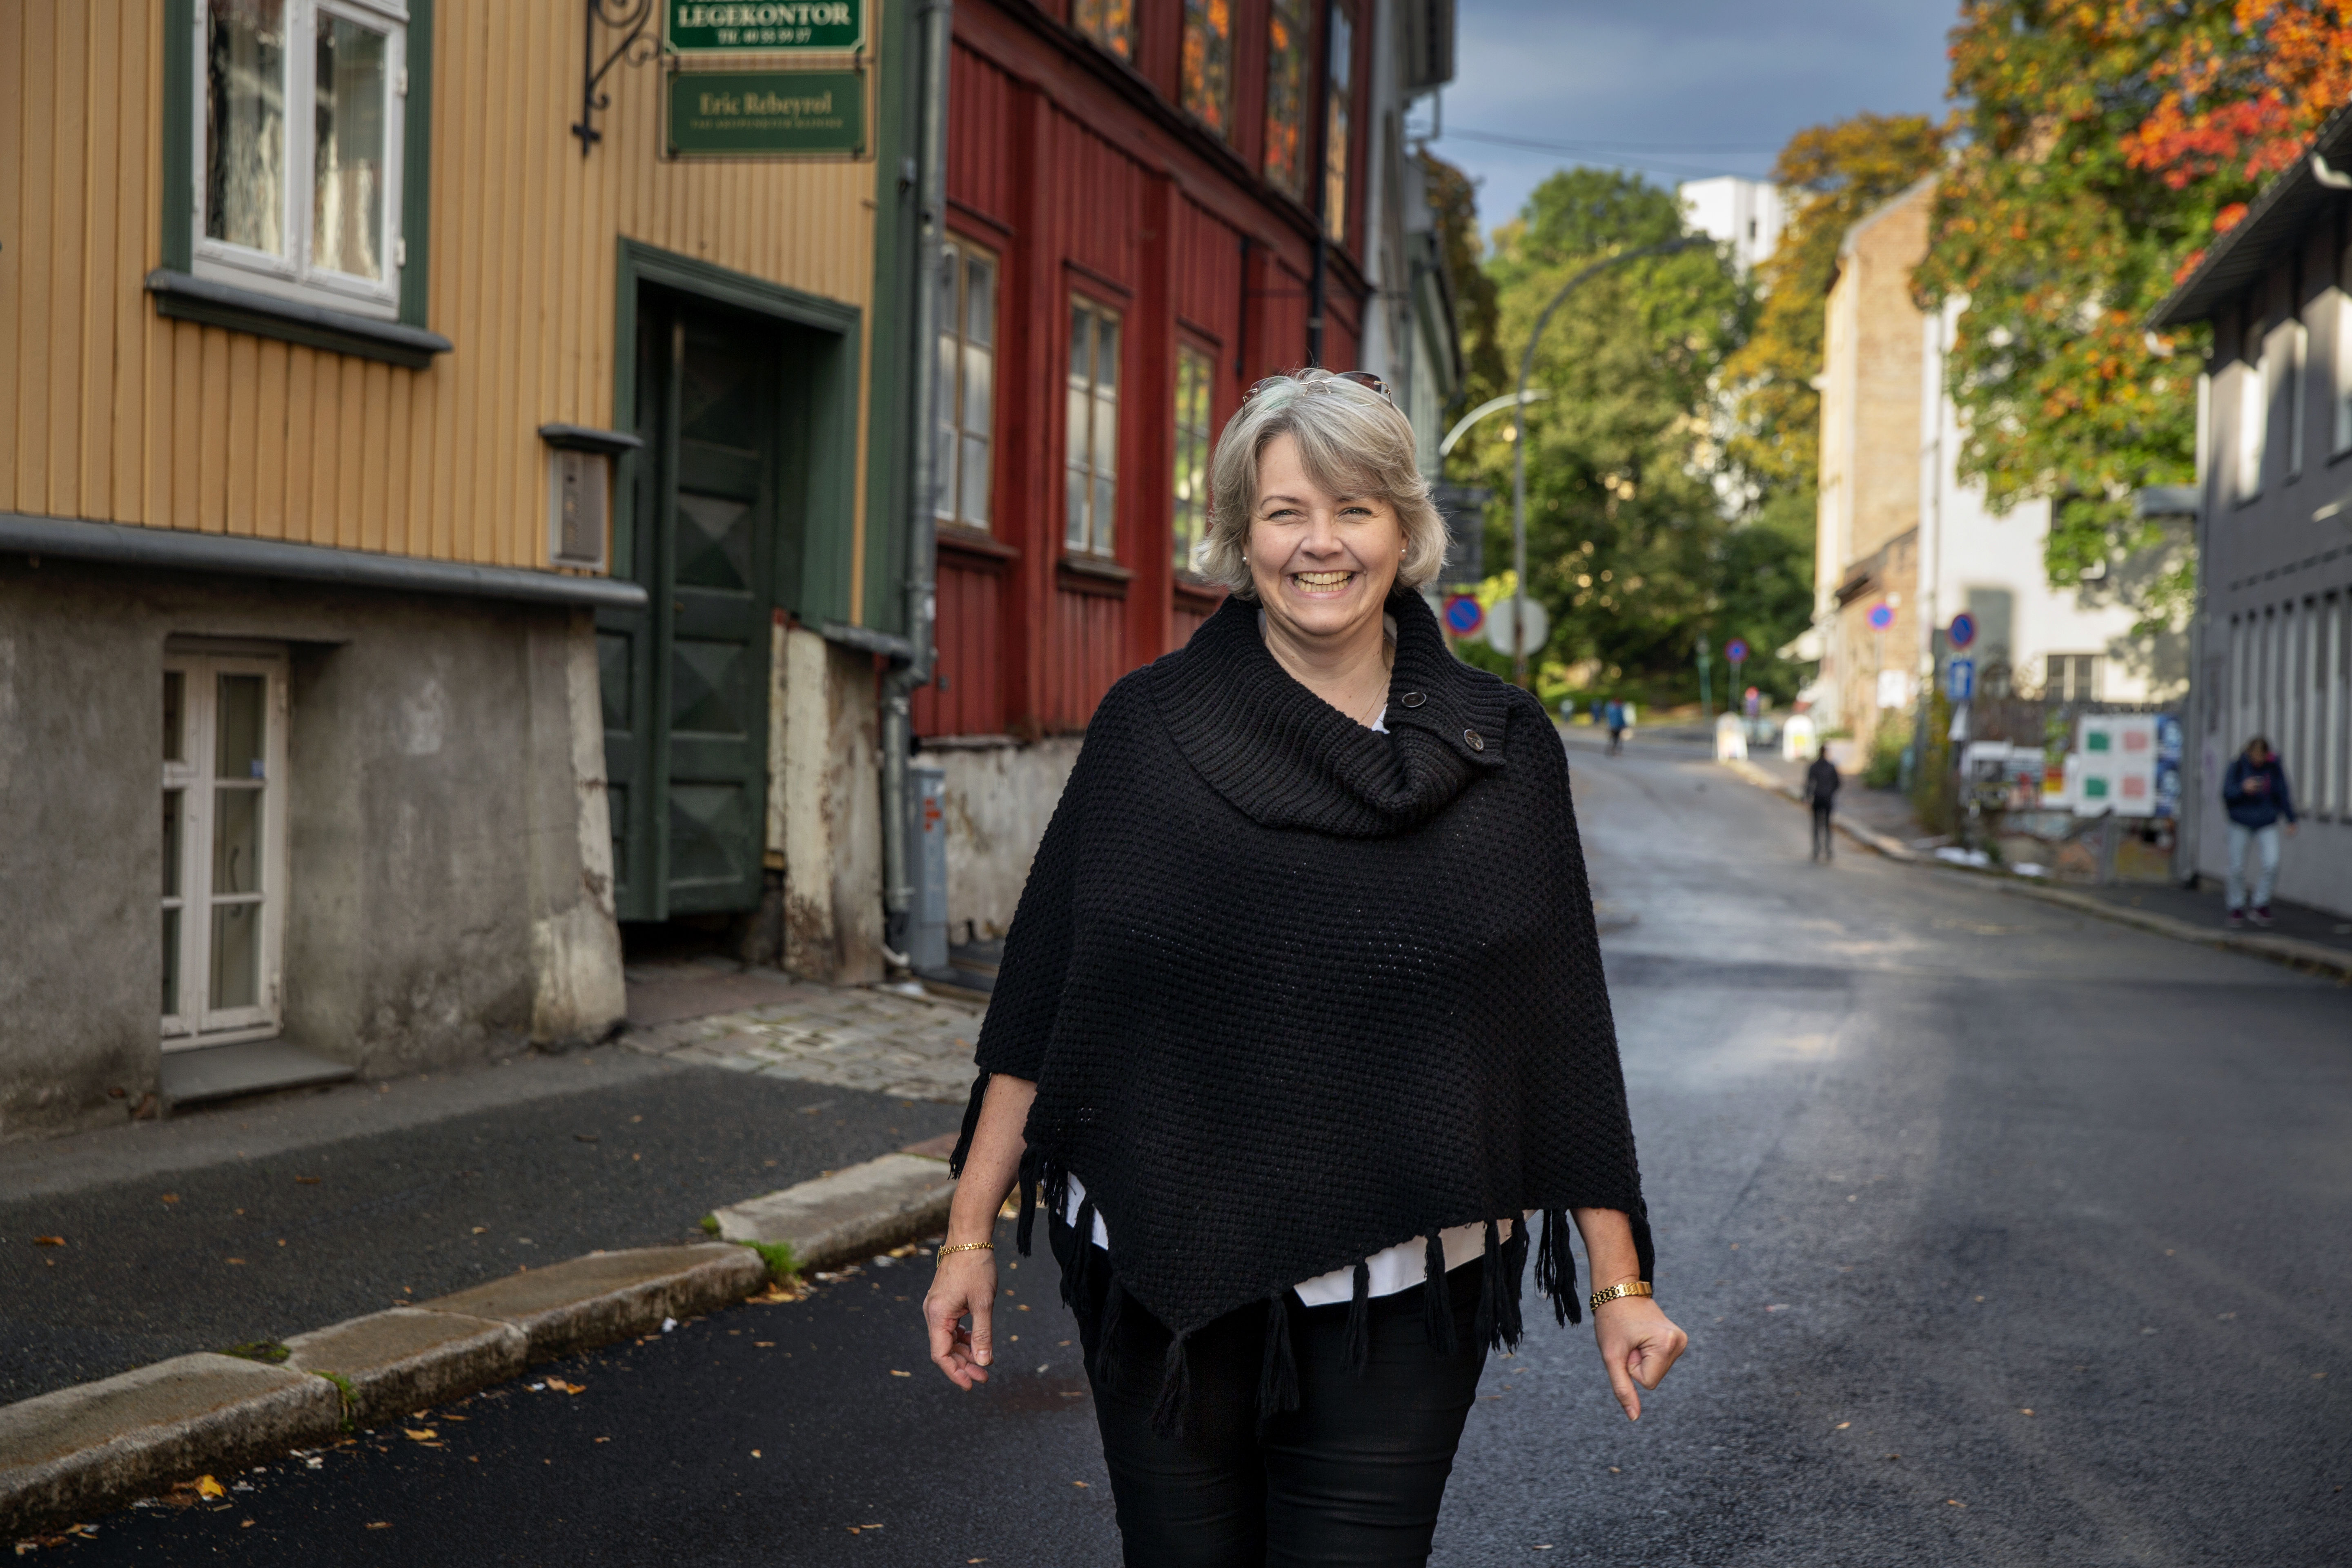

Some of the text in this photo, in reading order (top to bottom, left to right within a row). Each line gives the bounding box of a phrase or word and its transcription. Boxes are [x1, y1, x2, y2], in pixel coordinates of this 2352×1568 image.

[678, 2, 851, 27] LEGEKONTOR
[700, 90, 832, 119] Eric Rebeyrol
